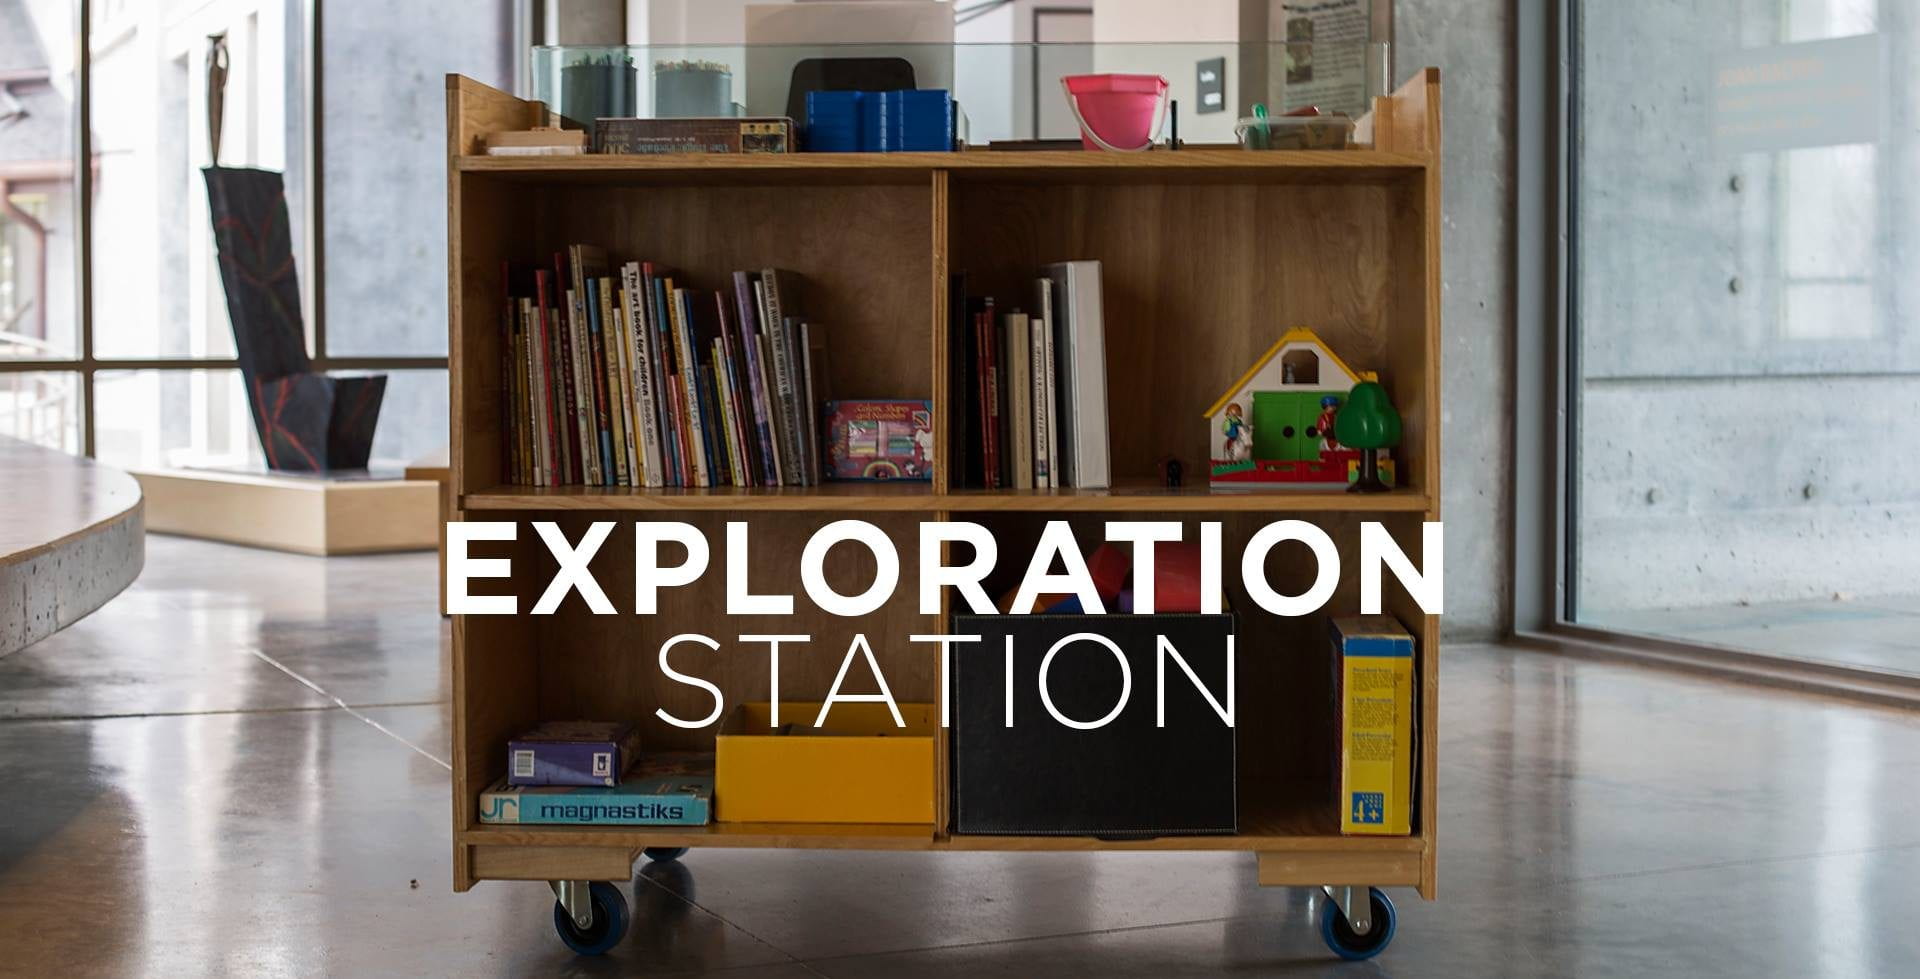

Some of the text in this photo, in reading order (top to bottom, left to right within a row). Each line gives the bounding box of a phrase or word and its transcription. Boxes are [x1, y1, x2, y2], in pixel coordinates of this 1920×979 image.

[630, 271, 638, 289] The
[632, 293, 640, 307] art
[634, 311, 642, 336] book
[639, 356, 649, 396] children
[643, 399, 652, 425] Book
[646, 427, 655, 446] one
[541, 803, 684, 822] magnastiks
[1353, 800, 1380, 822] 4+
